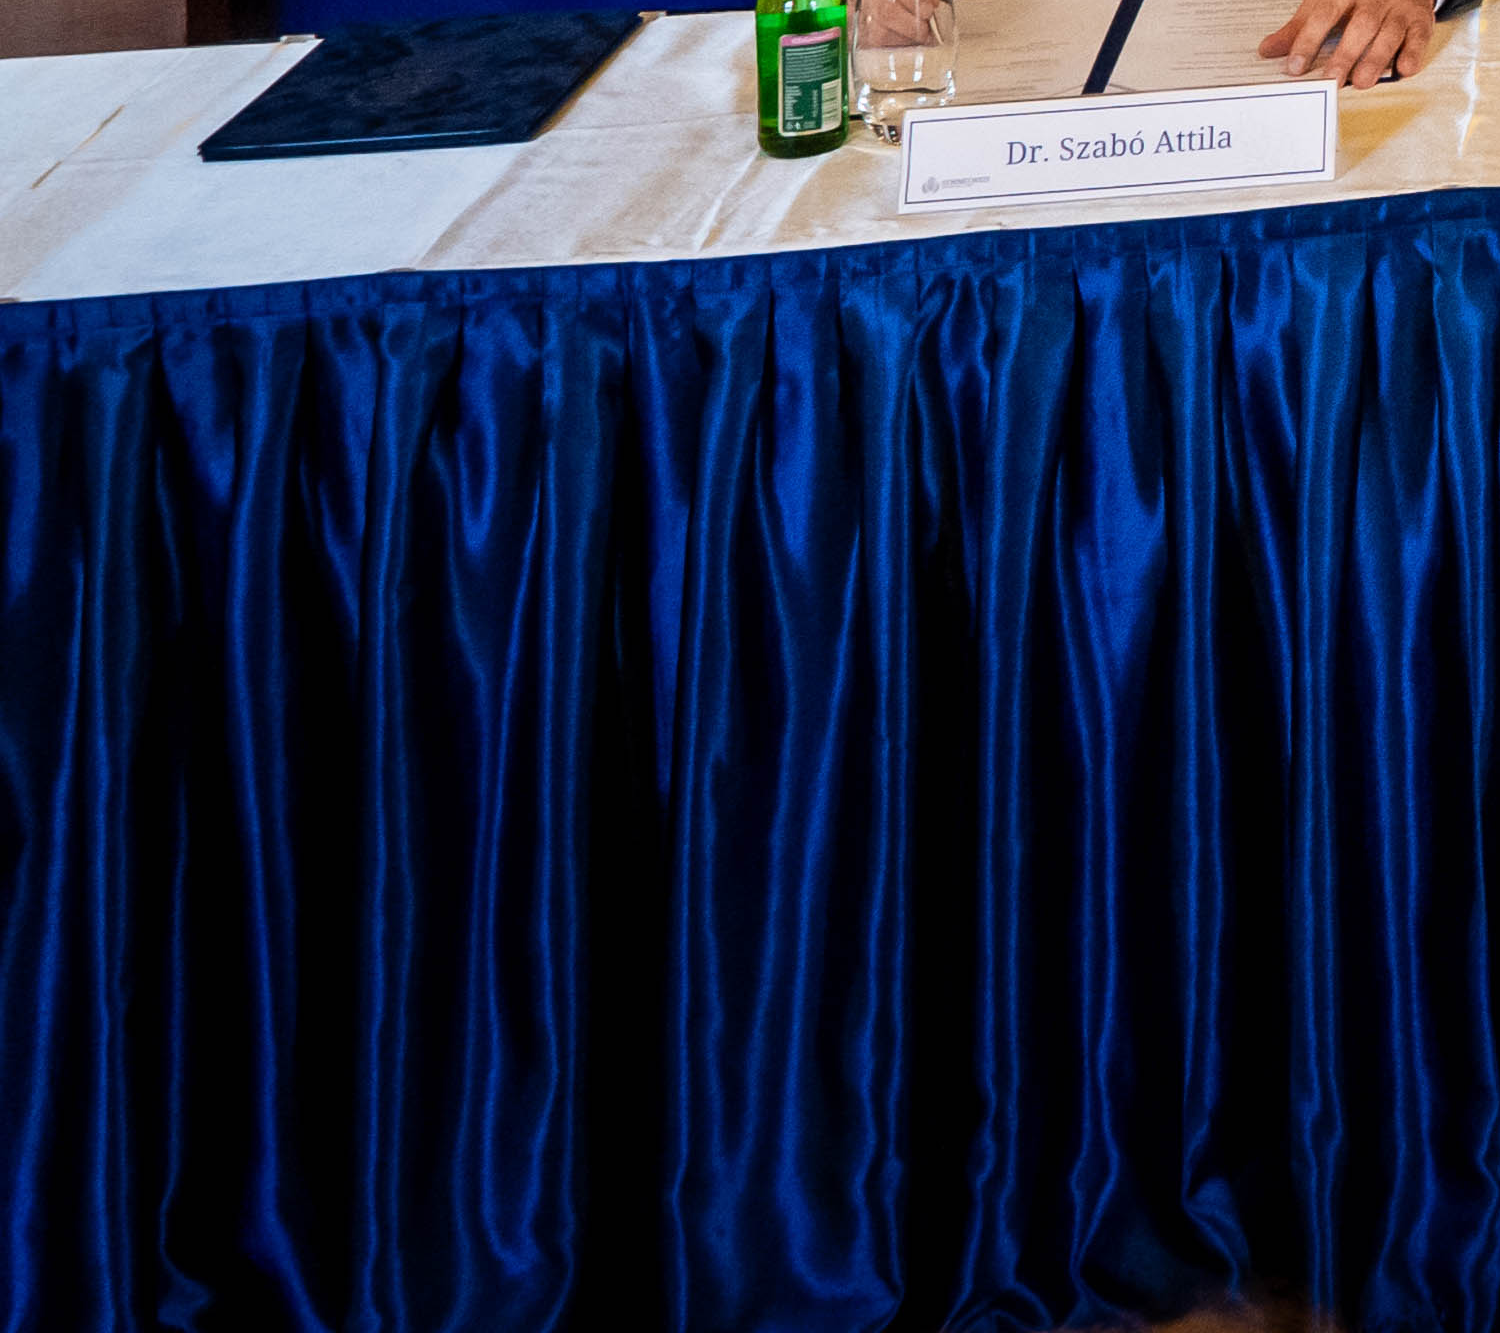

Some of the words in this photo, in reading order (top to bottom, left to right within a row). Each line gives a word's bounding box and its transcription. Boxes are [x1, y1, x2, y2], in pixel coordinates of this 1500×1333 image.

[1005, 136, 1049, 166] Dr.
[1059, 128, 1147, 162] Szabó
[1153, 124, 1232, 155] Attila
